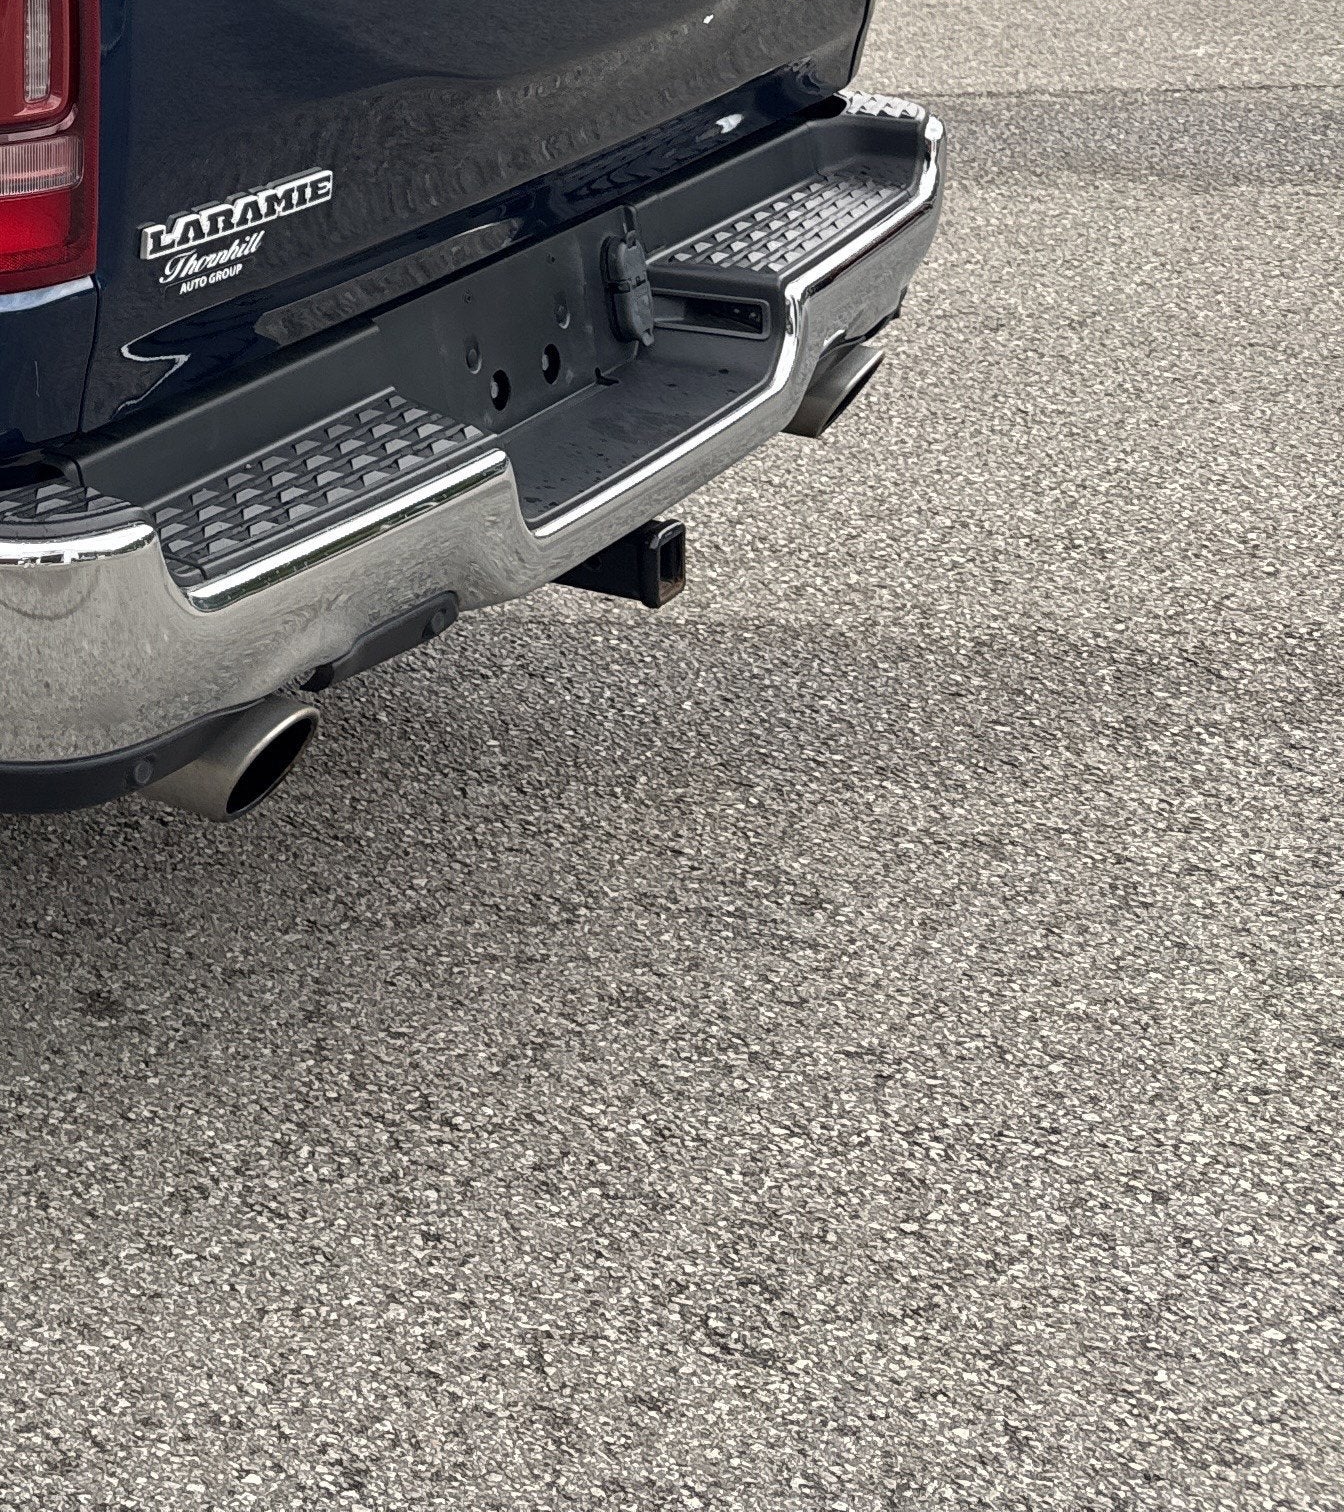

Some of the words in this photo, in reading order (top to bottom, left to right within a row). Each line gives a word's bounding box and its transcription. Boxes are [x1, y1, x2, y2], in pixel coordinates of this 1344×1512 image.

[140, 169, 333, 260] LARAMIE
[159, 230, 265, 284] Thornhill
[178, 276, 208, 296] AUTO
[208, 263, 244, 285] GROUP
